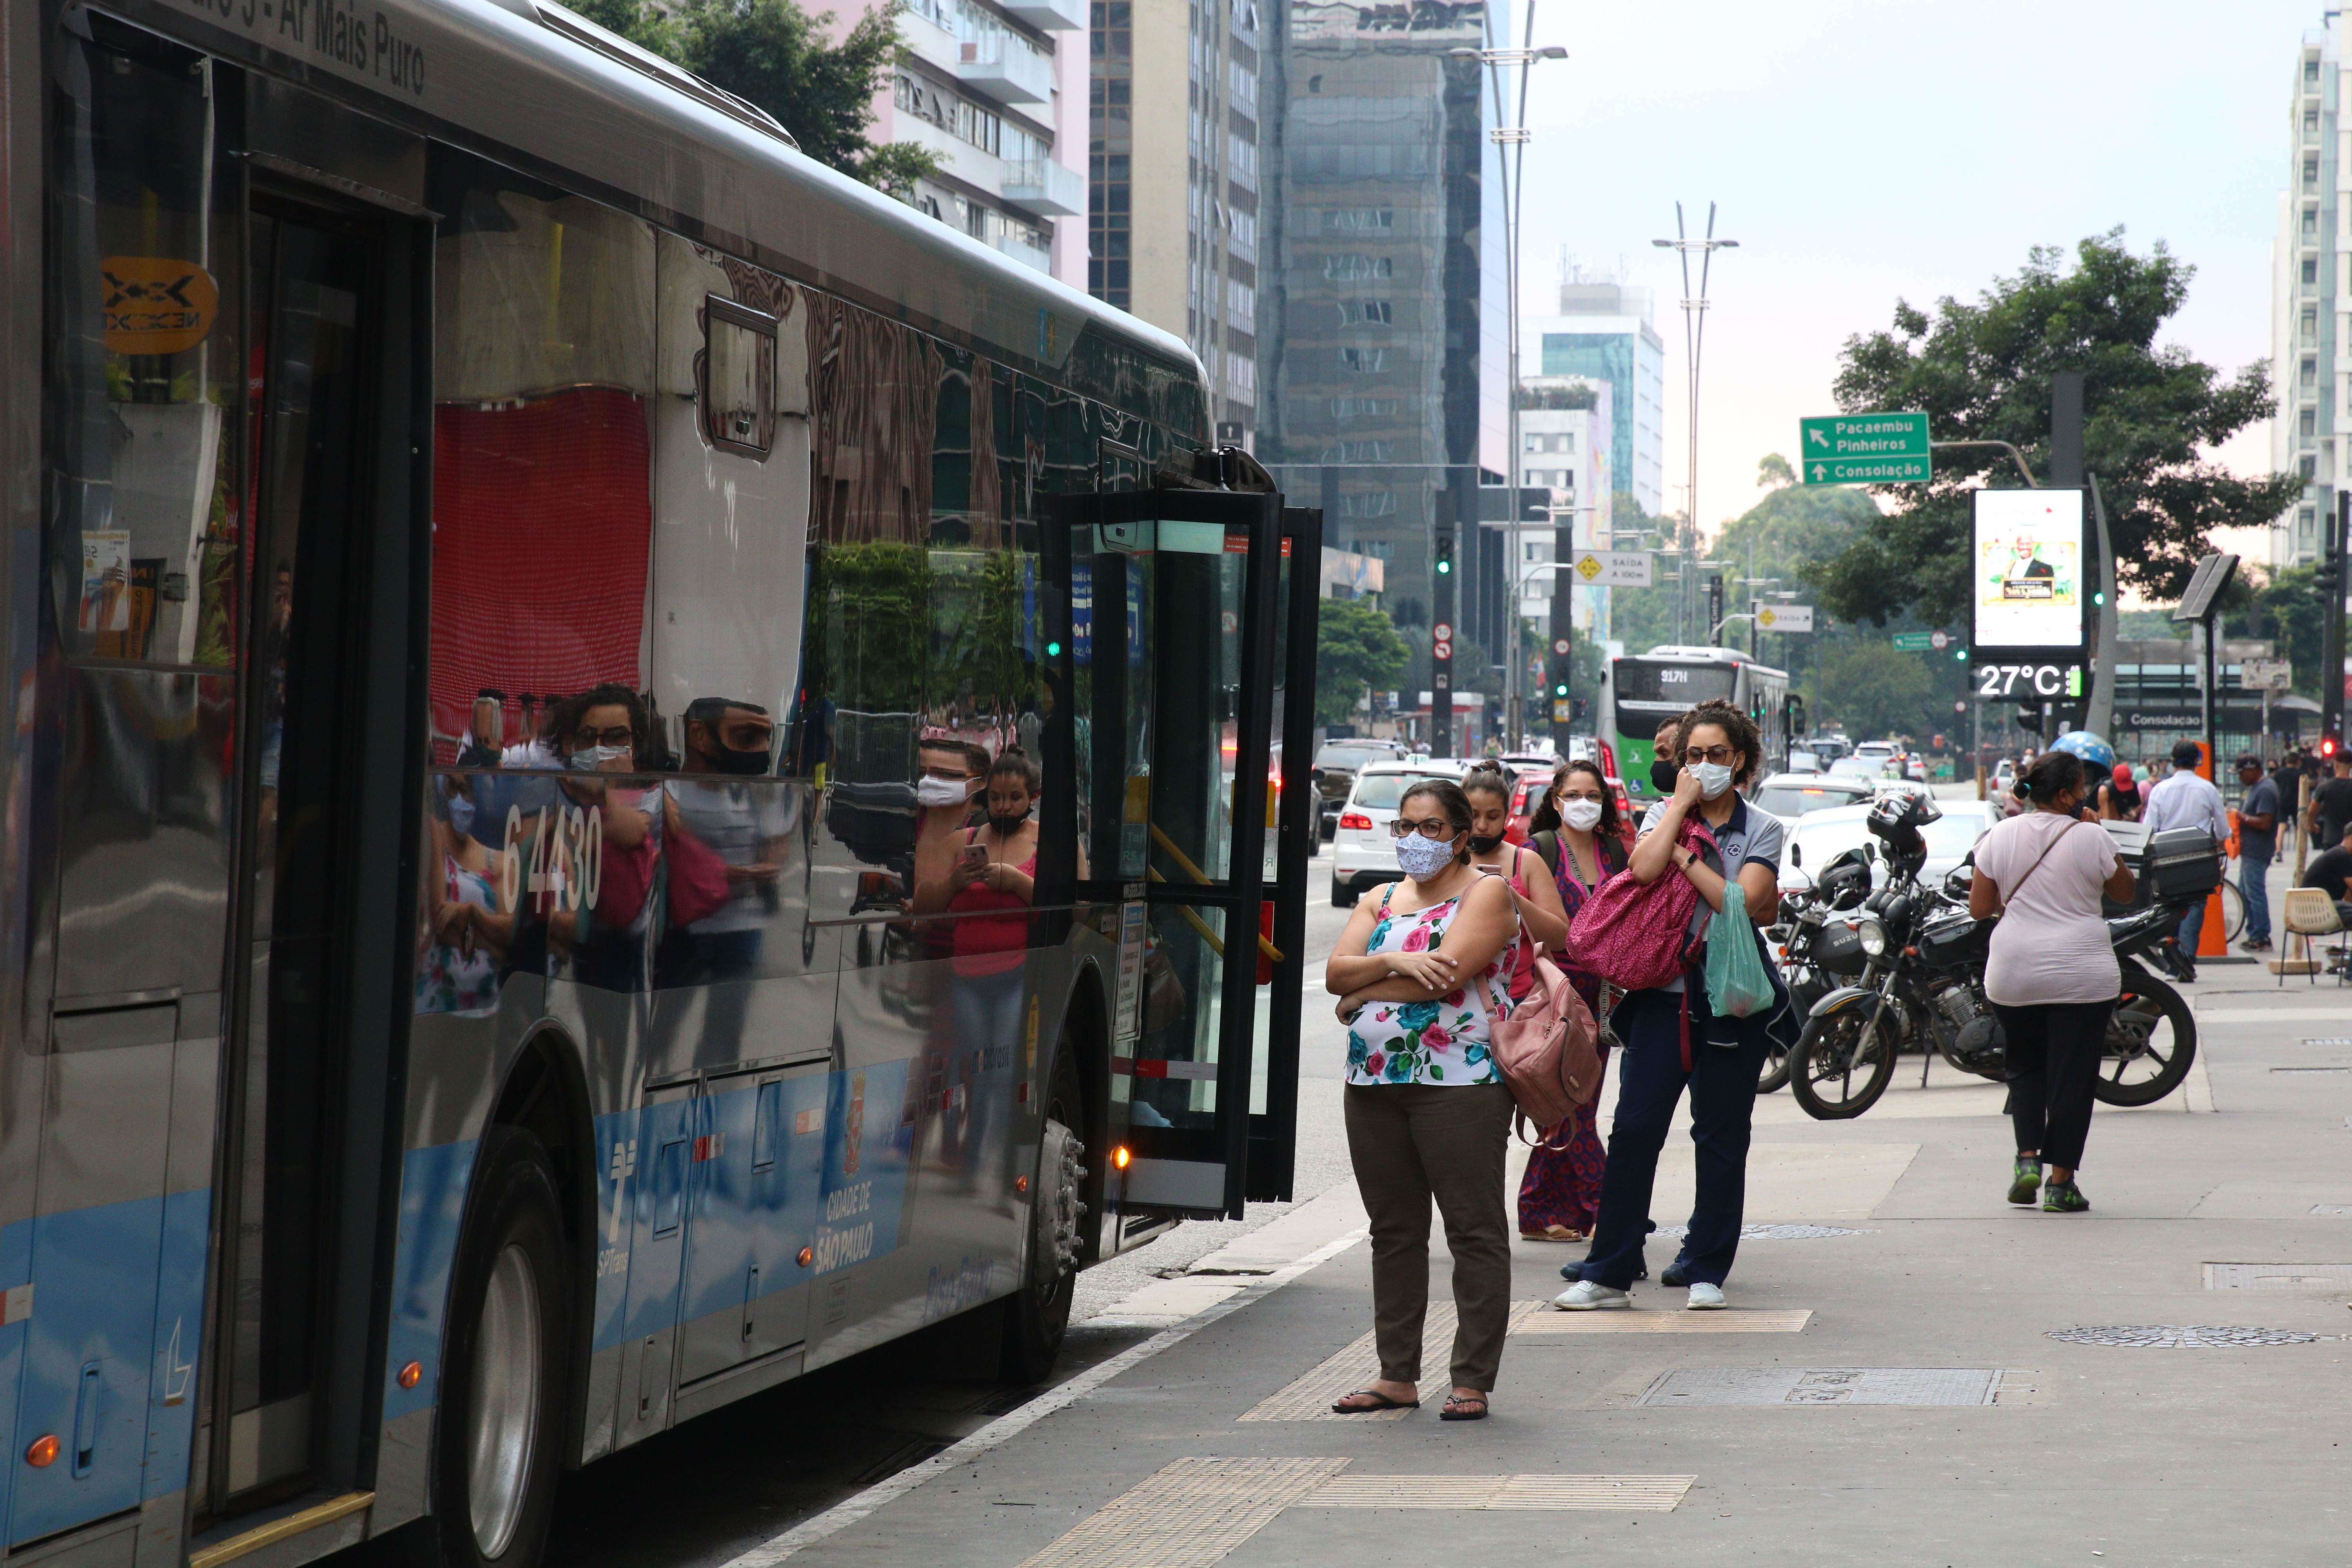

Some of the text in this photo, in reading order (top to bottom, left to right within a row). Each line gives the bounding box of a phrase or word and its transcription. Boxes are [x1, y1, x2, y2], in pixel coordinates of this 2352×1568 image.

[279, 0, 307, 43] Ar
[315, 0, 367, 71] Mais
[375, 11, 425, 96] Puro
[1836, 421, 1913, 434] Pacaembu
[1837, 439, 1906, 452] Pinheiros
[1835, 463, 1922, 478] Consolação
[1612, 558, 1643, 567] SAÍDA
[1661, 670, 1688, 683] 917H
[1980, 665, 2061, 695] 27°C
[503, 804, 602, 914] 6 4430
[1833, 933, 1858, 947] SUZU
[827, 1180, 872, 1223] CIDADE DE
[815, 1221, 873, 1275] SÃO PAULO
[597, 1248, 629, 1278] SPTrans
